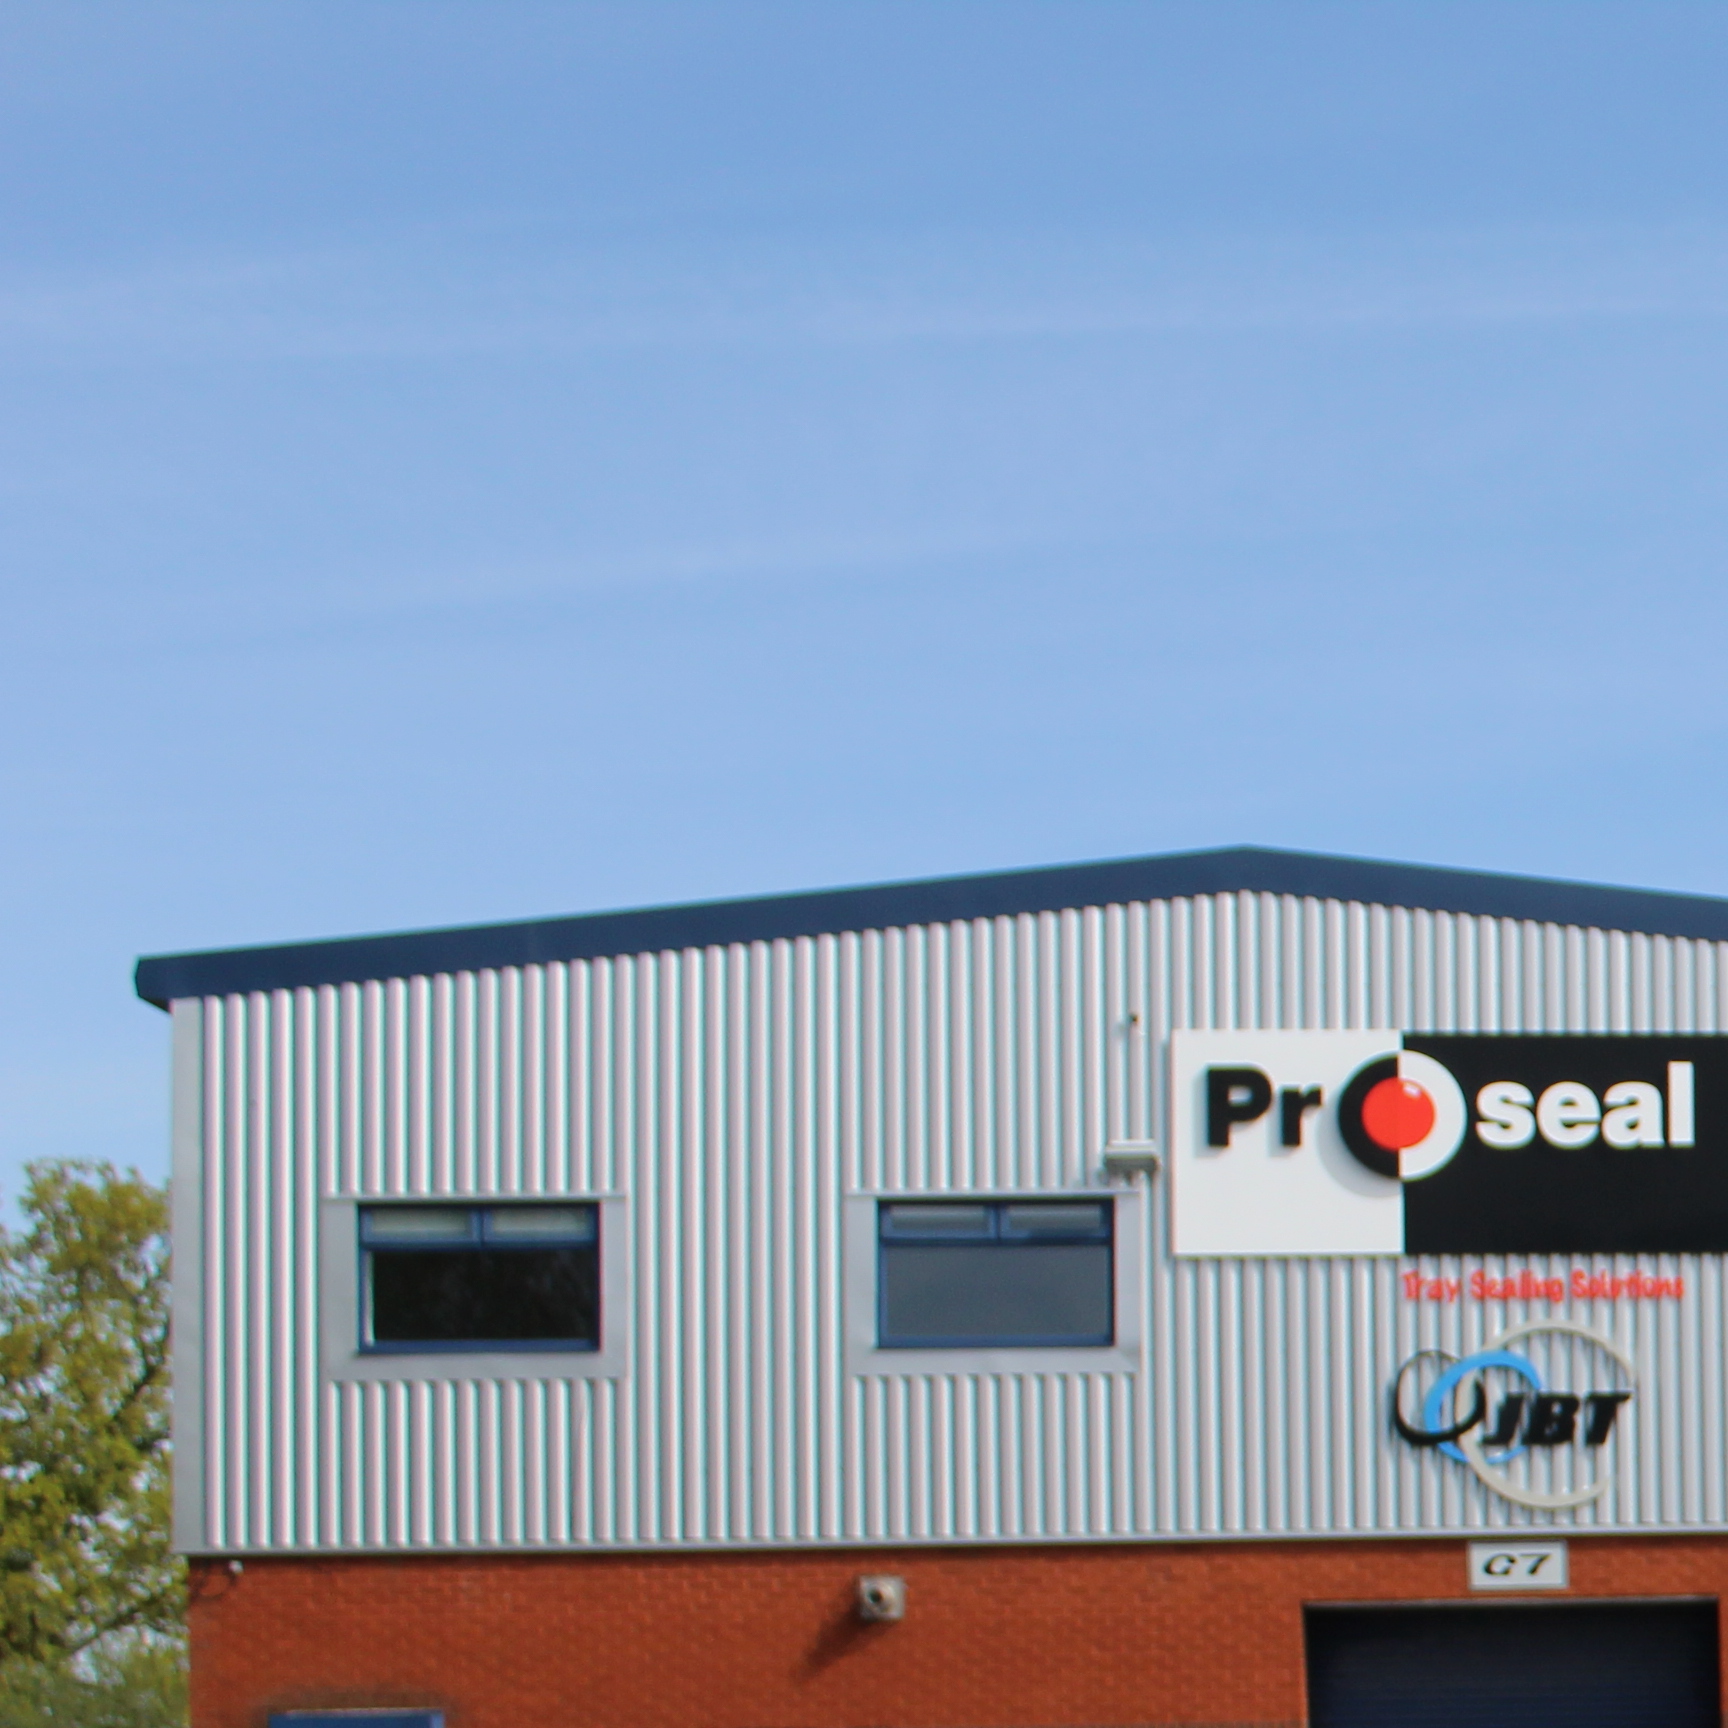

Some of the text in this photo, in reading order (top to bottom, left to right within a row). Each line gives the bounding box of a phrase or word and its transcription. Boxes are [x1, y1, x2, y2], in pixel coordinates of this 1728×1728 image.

[1403, 1269, 1684, 1304] Tray Sealing Solutions
[1482, 1391, 1634, 1446] JBT
